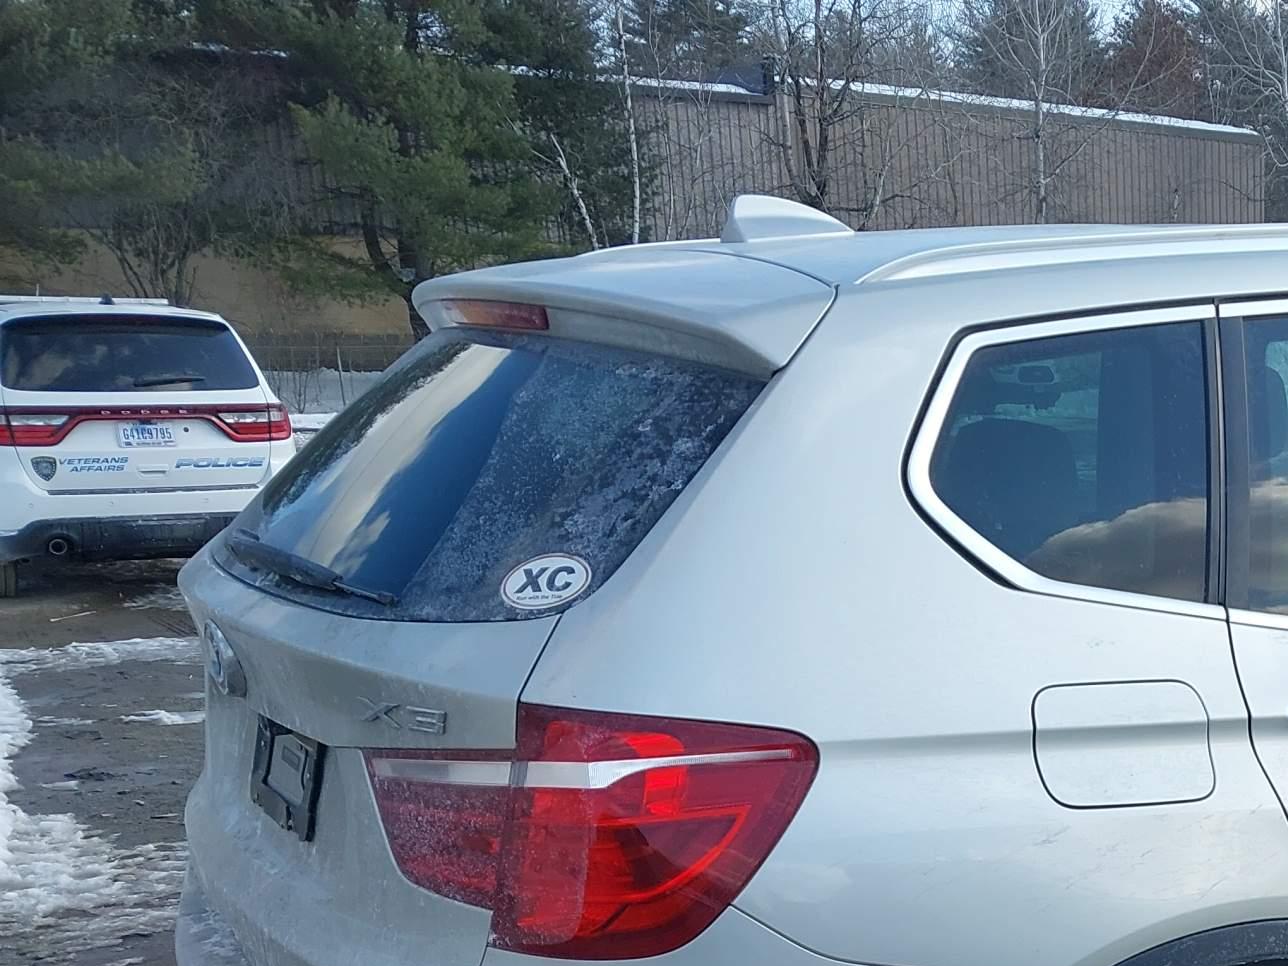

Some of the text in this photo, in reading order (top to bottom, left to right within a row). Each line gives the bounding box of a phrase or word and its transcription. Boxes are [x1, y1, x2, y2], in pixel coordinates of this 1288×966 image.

[58, 456, 129, 465] VETERANS
[175, 457, 265, 468] POLICE
[513, 565, 576, 594] XC
[356, 695, 448, 736] X3
